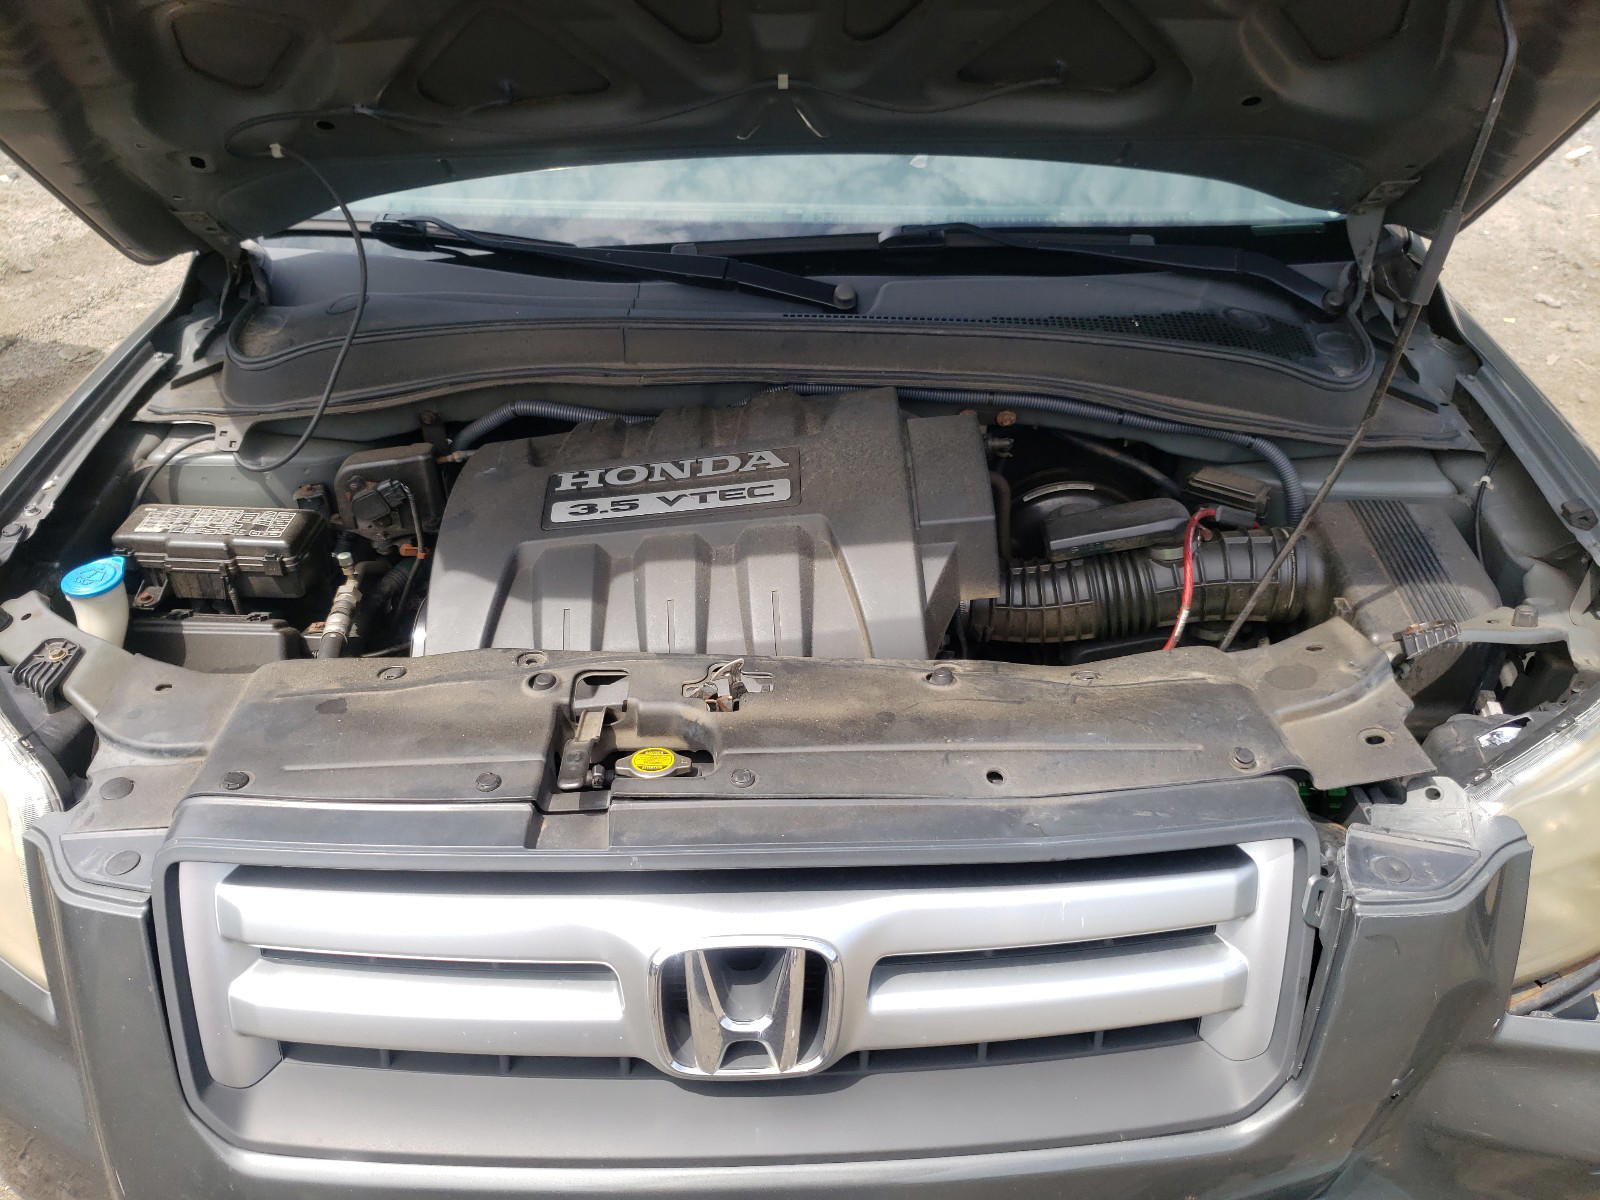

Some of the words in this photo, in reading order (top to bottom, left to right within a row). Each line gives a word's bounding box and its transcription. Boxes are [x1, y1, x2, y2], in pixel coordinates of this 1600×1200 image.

[554, 450, 790, 491] HONDA
[568, 498, 640, 517] 3.5
[657, 484, 775, 507] VTEC
